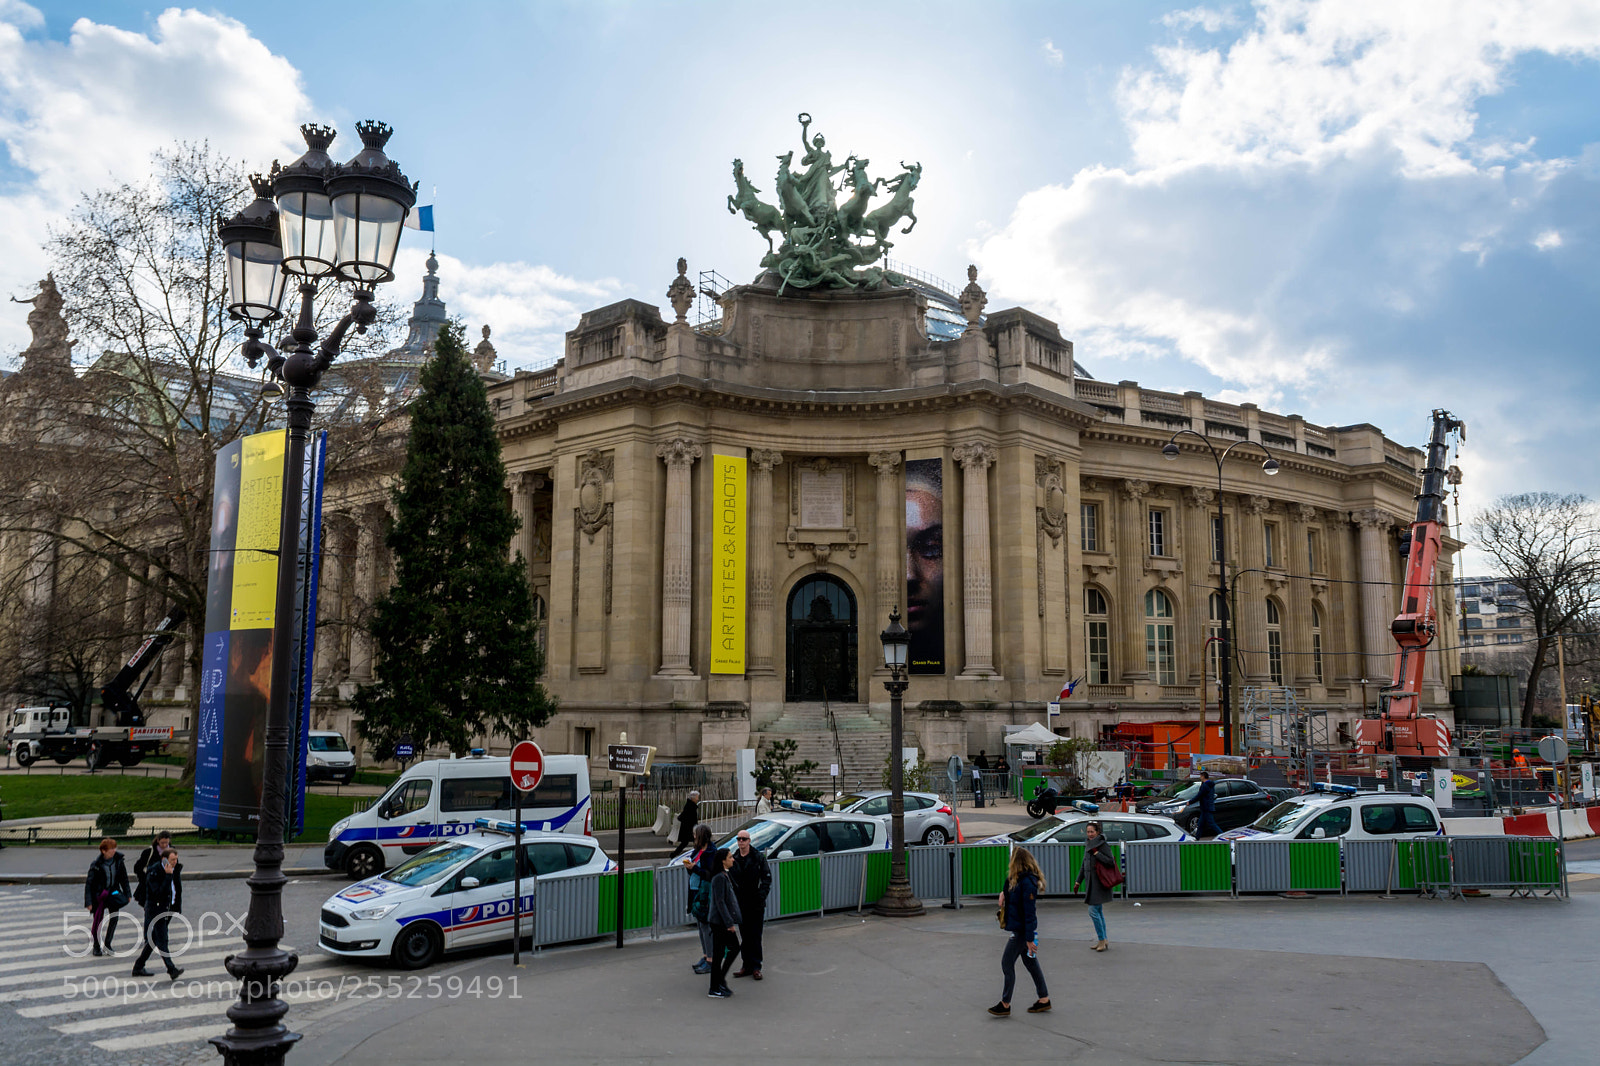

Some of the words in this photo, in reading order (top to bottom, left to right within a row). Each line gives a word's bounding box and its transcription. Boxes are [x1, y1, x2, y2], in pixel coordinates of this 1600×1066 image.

[242, 475, 281, 495] ARTIST
[723, 465, 737, 536] ROBOTS
[722, 559, 735, 650] ARTISTES
[442, 825, 475, 836] POL
[482, 897, 530, 919] POLI
